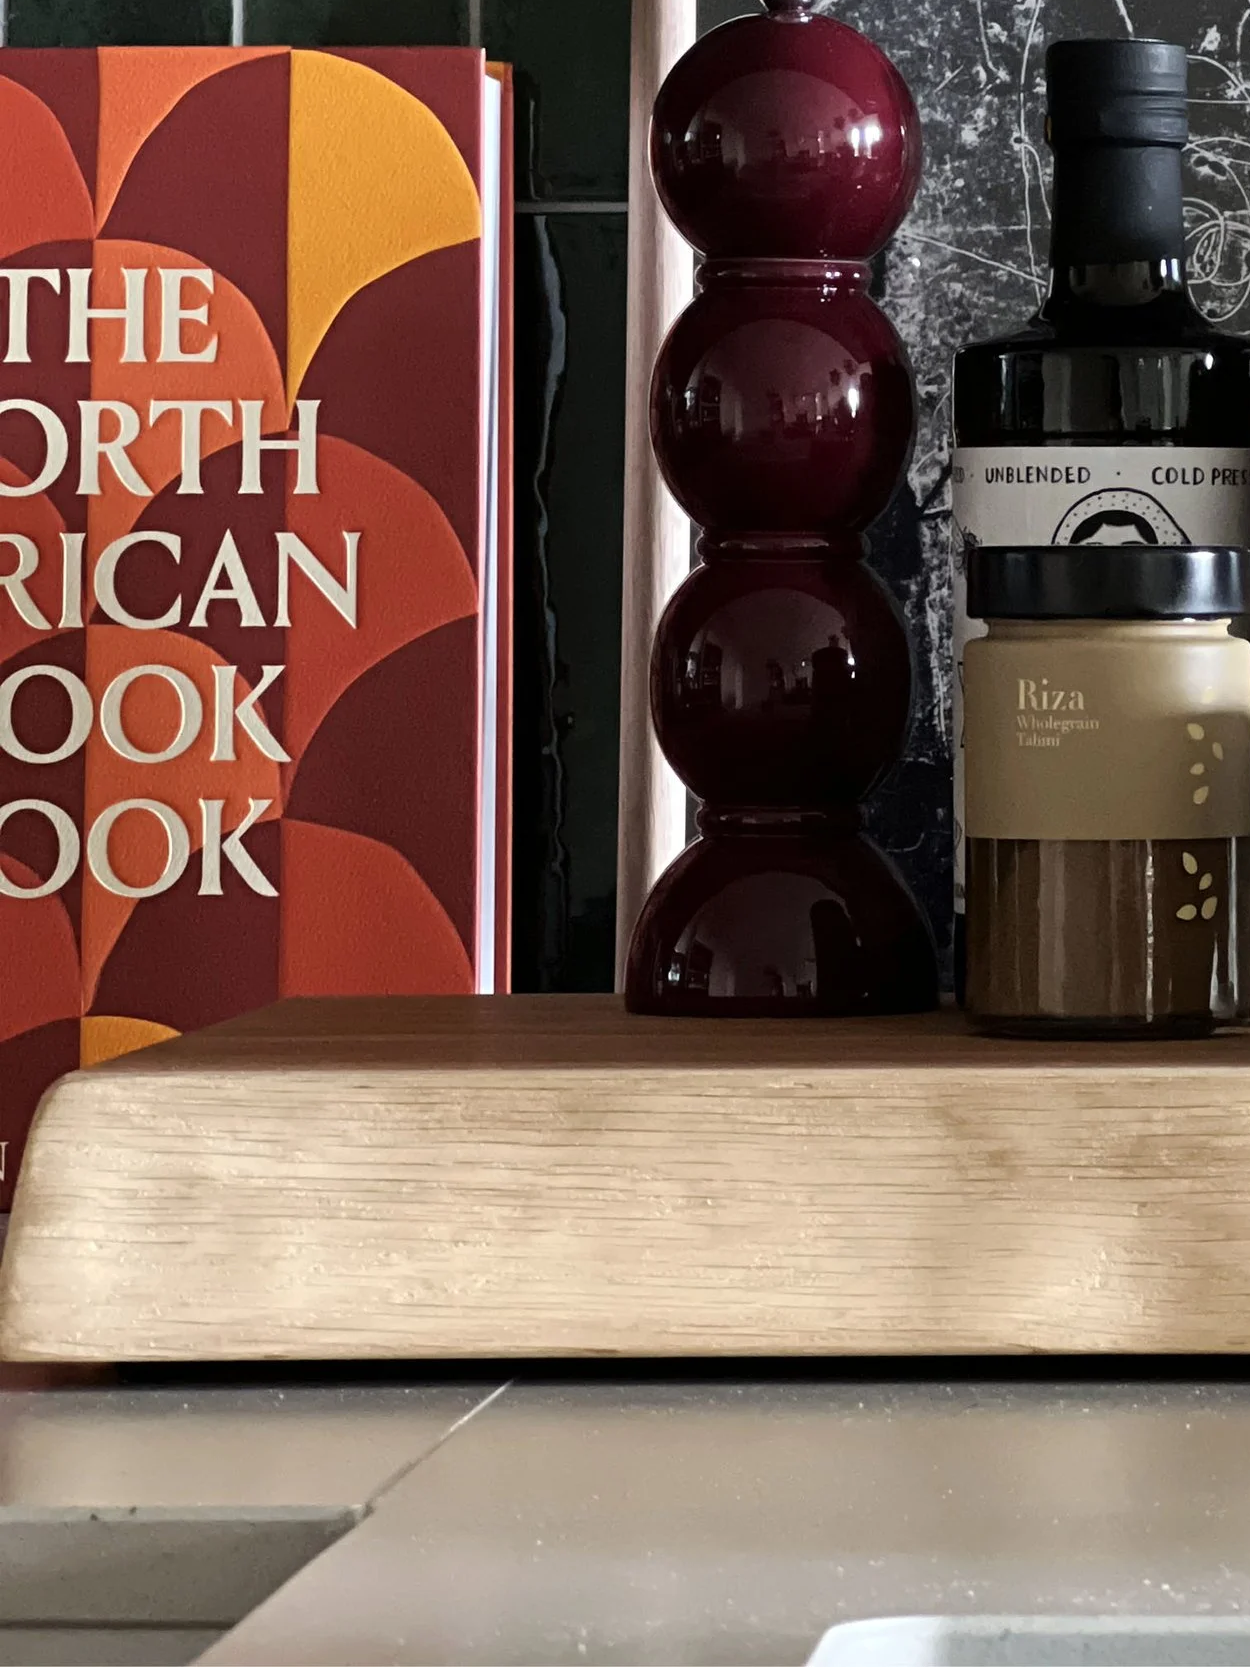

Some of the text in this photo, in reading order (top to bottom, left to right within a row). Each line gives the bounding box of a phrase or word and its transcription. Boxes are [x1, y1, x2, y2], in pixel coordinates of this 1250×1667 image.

[0, 267, 220, 363] THE
[0, 398, 322, 498] ORTH
[984, 465, 1092, 485] UNBLENDED
[1151, 466, 1205, 486] COLD
[0, 663, 292, 765] OOK
[1016, 677, 1085, 712] Riza
[1016, 714, 1100, 734] Wholegrain
[0, 798, 280, 900] OOK
